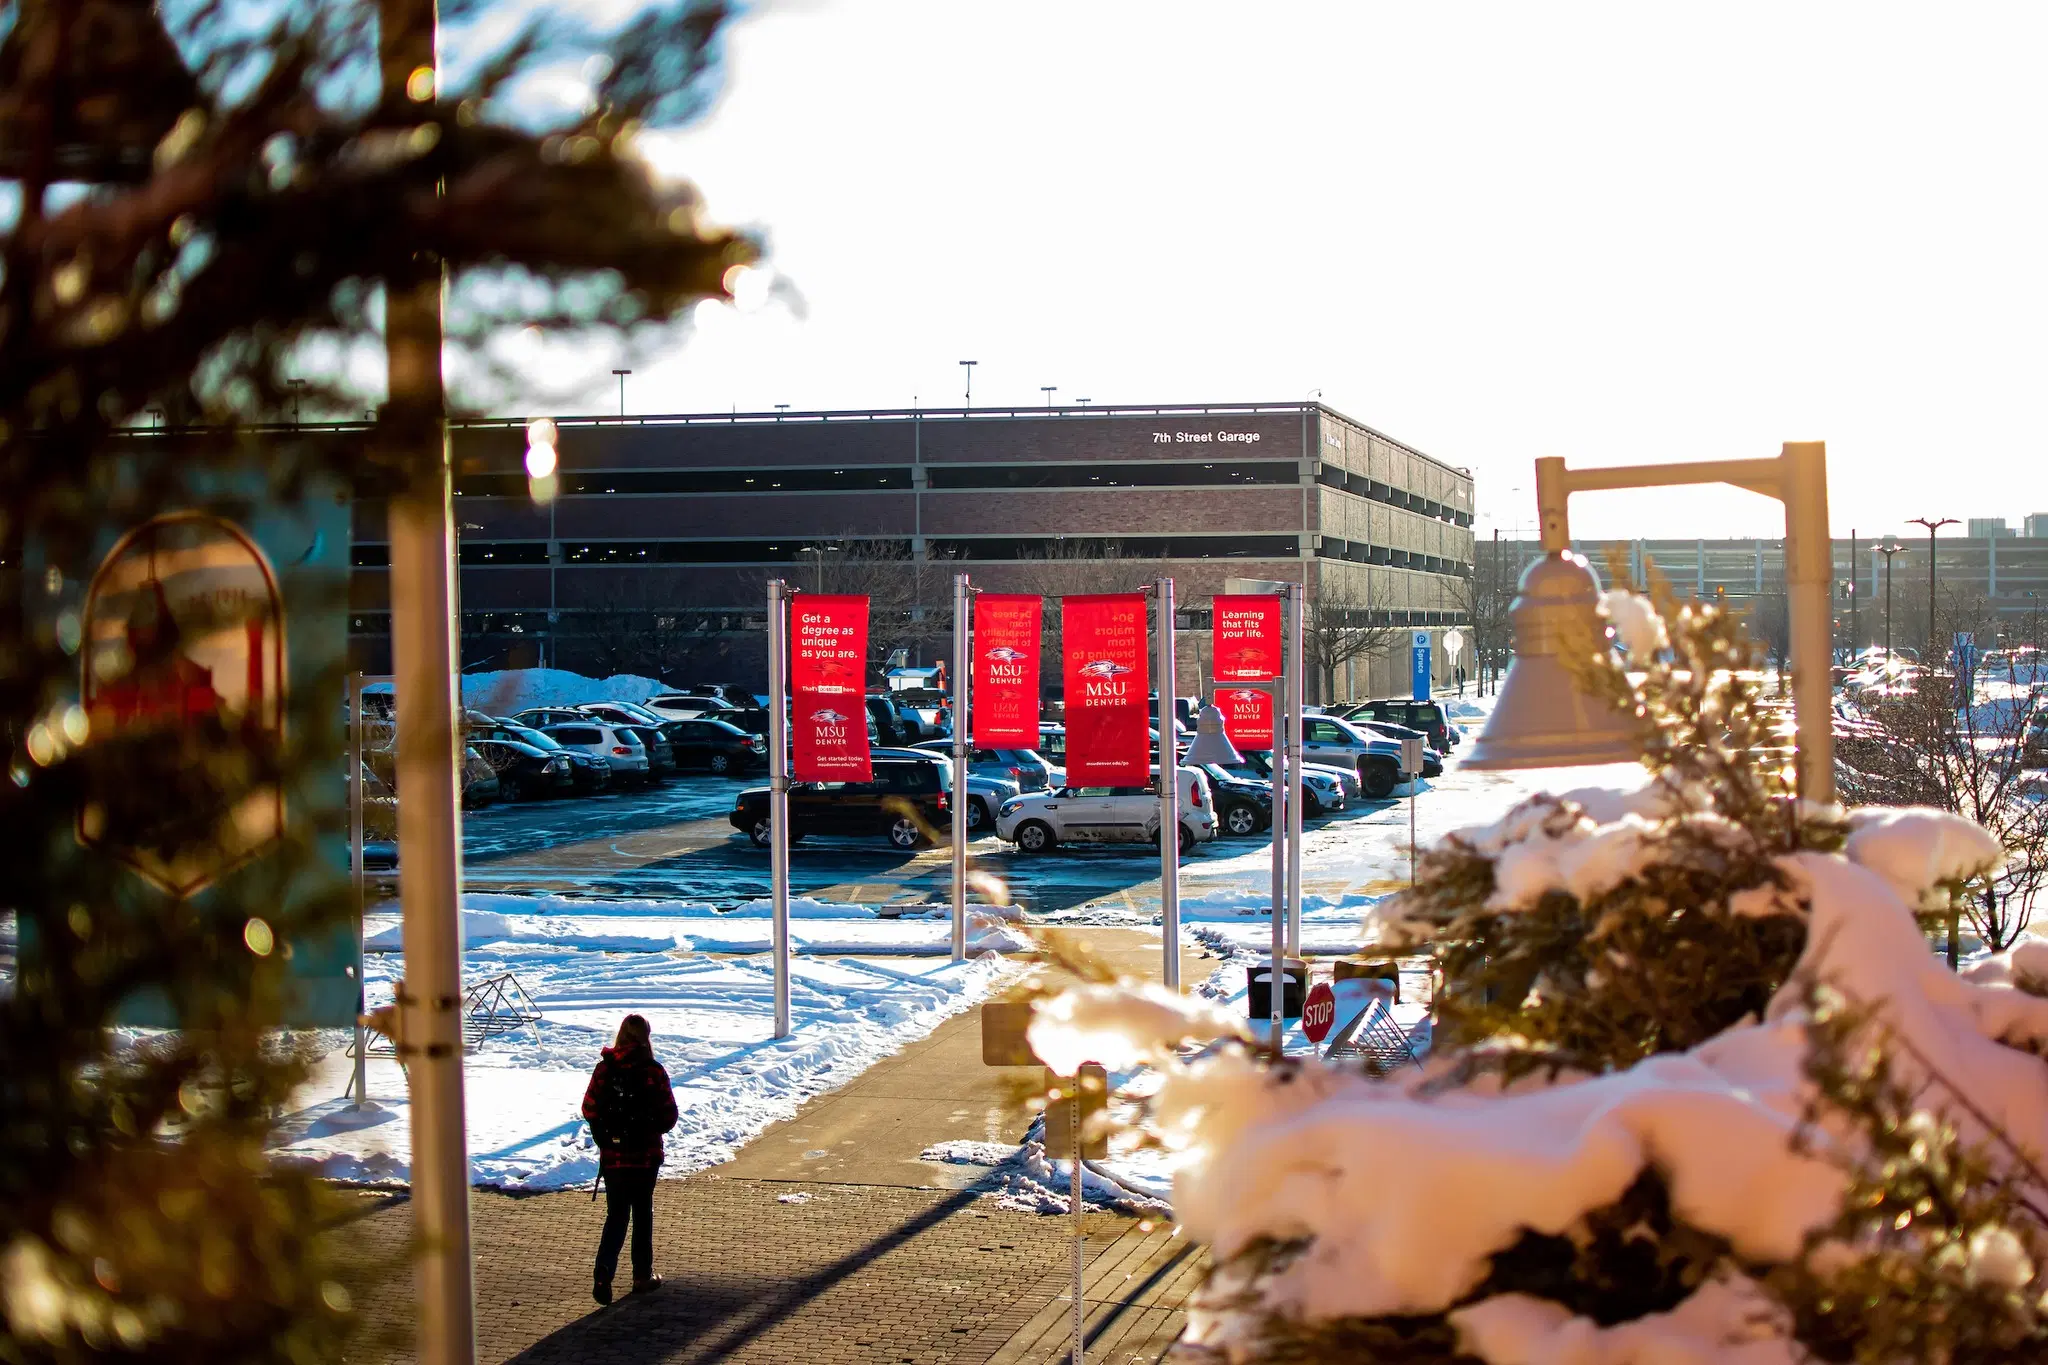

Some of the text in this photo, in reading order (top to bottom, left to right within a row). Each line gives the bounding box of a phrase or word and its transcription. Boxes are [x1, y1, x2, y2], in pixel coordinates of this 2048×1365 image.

[1152, 430, 1261, 444] 7th Street Garage
[801, 613, 831, 623] Get a
[1222, 611, 1264, 620] Learning
[1222, 620, 1260, 628] that fits
[801, 625, 854, 636] degree as
[1222, 630, 1264, 639] your life.
[801, 637, 837, 647] unique
[801, 650, 858, 659] as you are.
[1416, 648, 1425, 674] Spruce
[990, 664, 1022, 677] MSU
[990, 677, 1022, 685] DENVER
[1086, 681, 1126, 696] MSU
[1086, 698, 1127, 706] DENVER
[1234, 704, 1261, 714] MSU
[815, 726, 846, 738] MSU
[815, 738, 847, 746] DENVER
[1305, 1001, 1333, 1027] STOP
